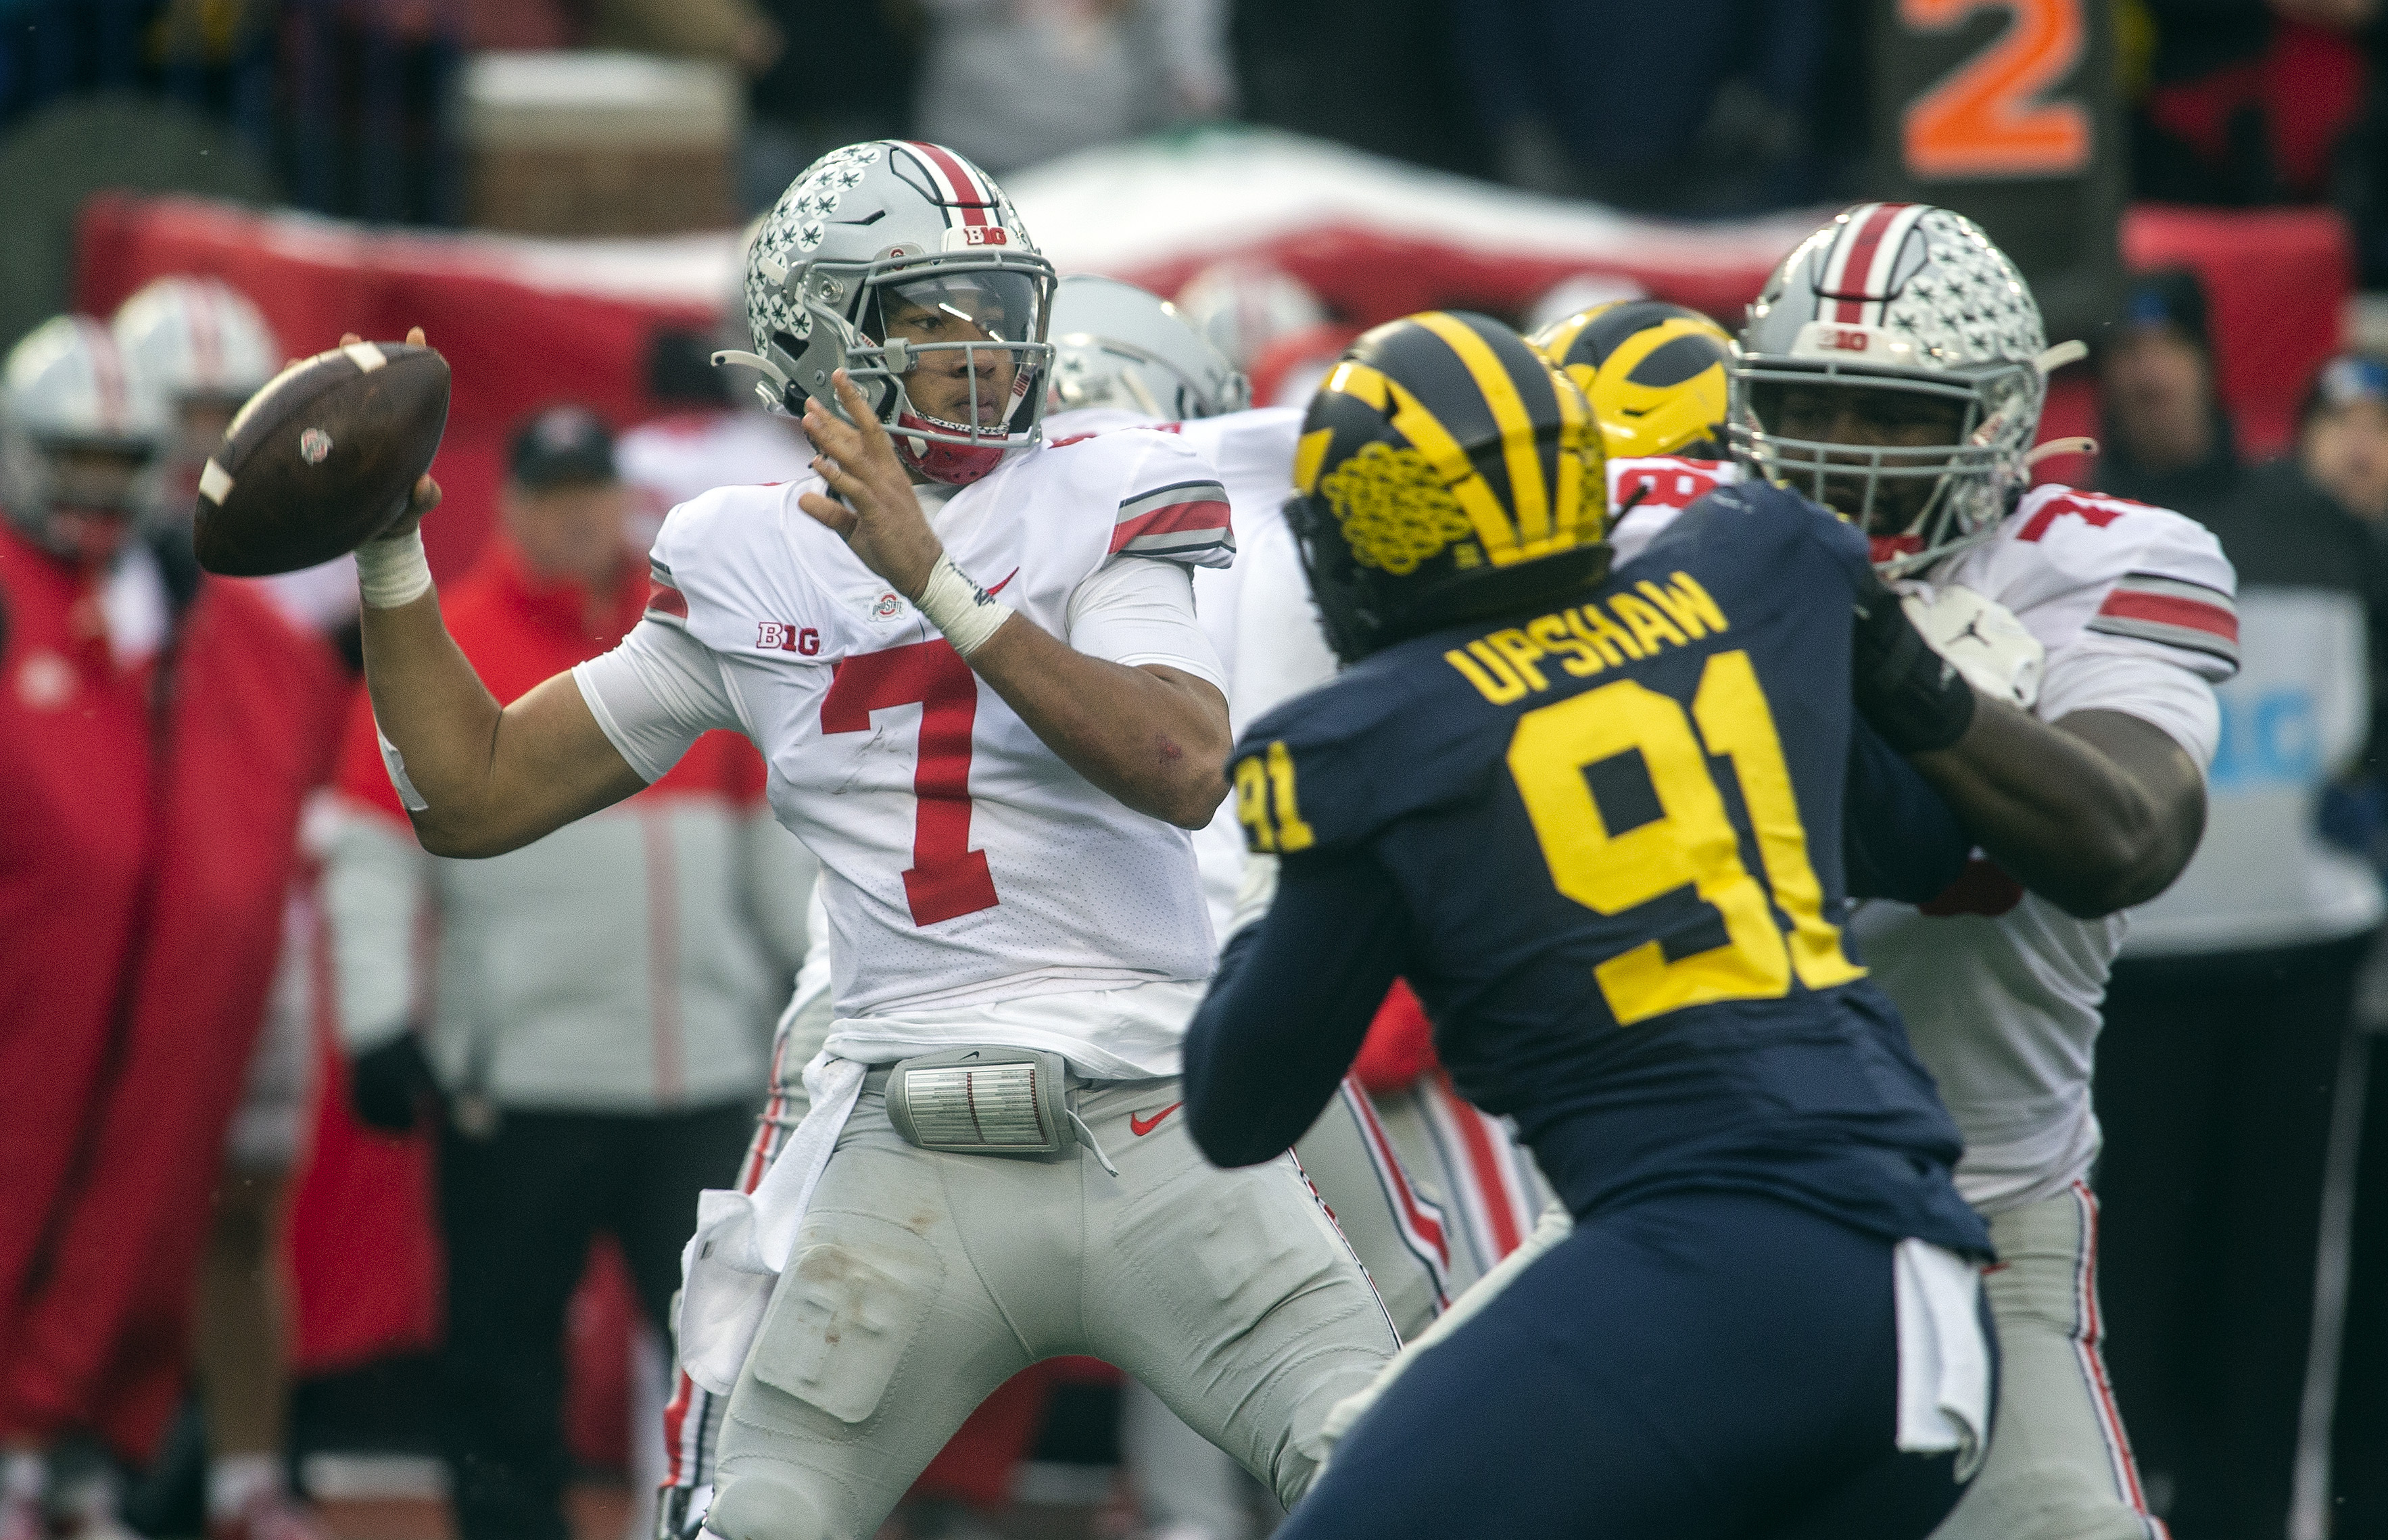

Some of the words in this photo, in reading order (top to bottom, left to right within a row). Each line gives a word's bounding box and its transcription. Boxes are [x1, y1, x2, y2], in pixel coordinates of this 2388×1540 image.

[1899, 0, 2091, 174] 2
[1443, 571, 1729, 706] UPSHAW
[820, 638, 1000, 927] 7
[1233, 740, 1316, 853] 91
[1506, 649, 1869, 1028] 91
